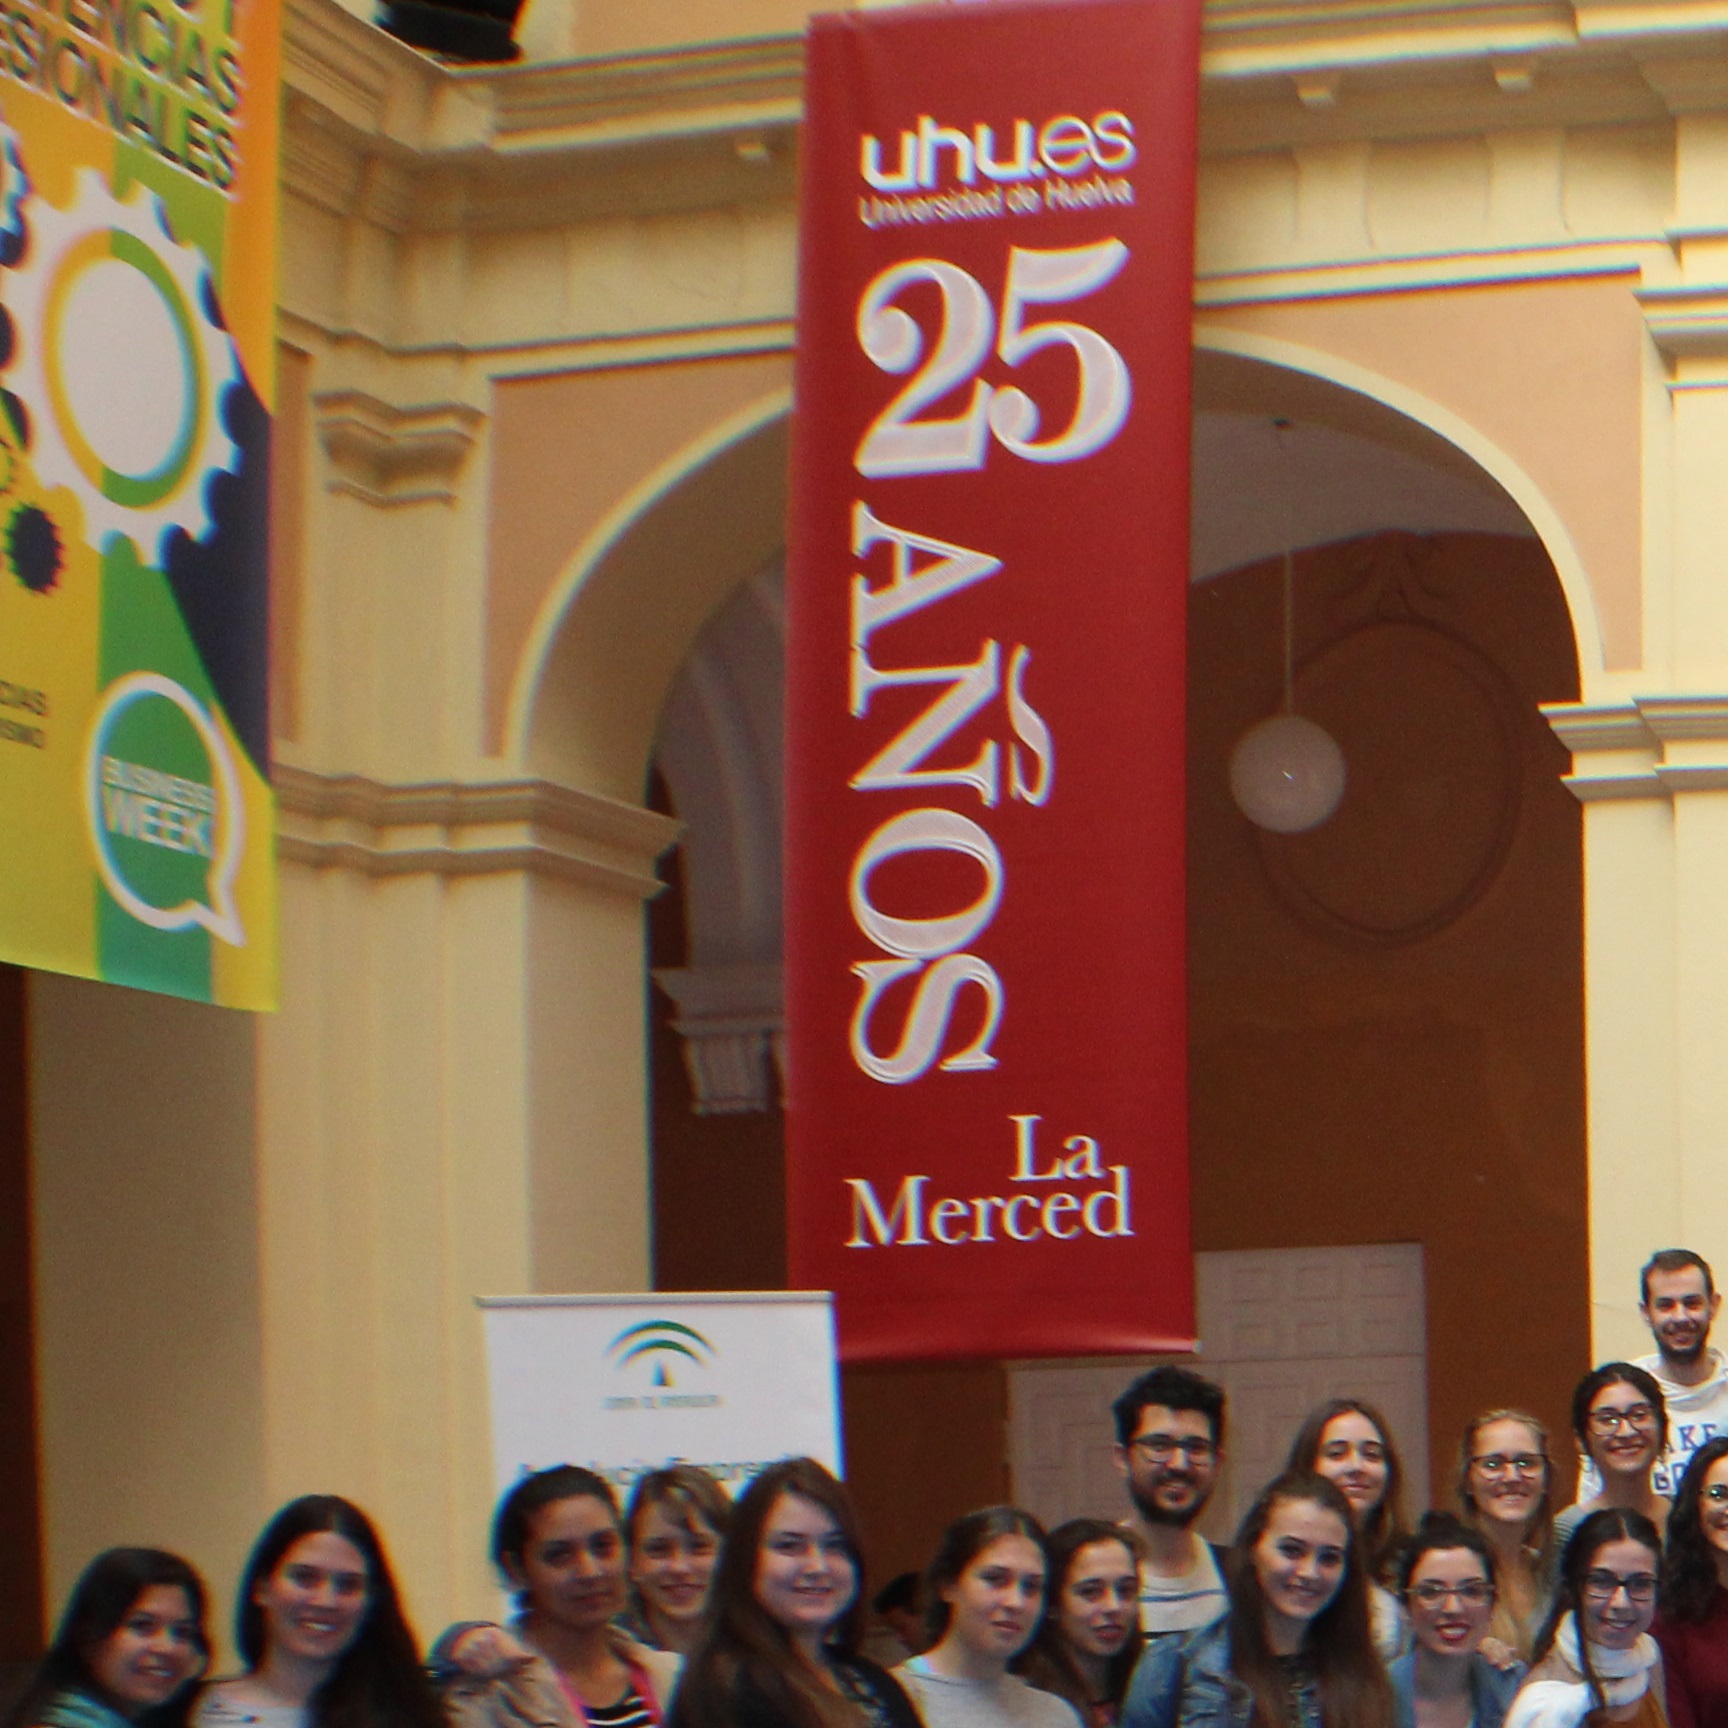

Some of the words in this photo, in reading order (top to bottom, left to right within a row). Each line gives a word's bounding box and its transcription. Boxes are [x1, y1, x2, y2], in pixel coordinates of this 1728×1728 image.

[0, 0, 241, 192] SIONALES
[38, 0, 243, 118] ENCIAS
[859, 110, 1137, 192] uhu.es
[859, 187, 1003, 230] Universidad
[1005, 181, 1041, 216] de
[1044, 174, 1136, 212] Huelva
[854, 236, 1133, 479] 25
[103, 785, 216, 860] WEEK
[850, 500, 1053, 1085] AÑOS
[1007, 1115, 1105, 1182] La
[843, 1165, 1135, 1249] Merced
